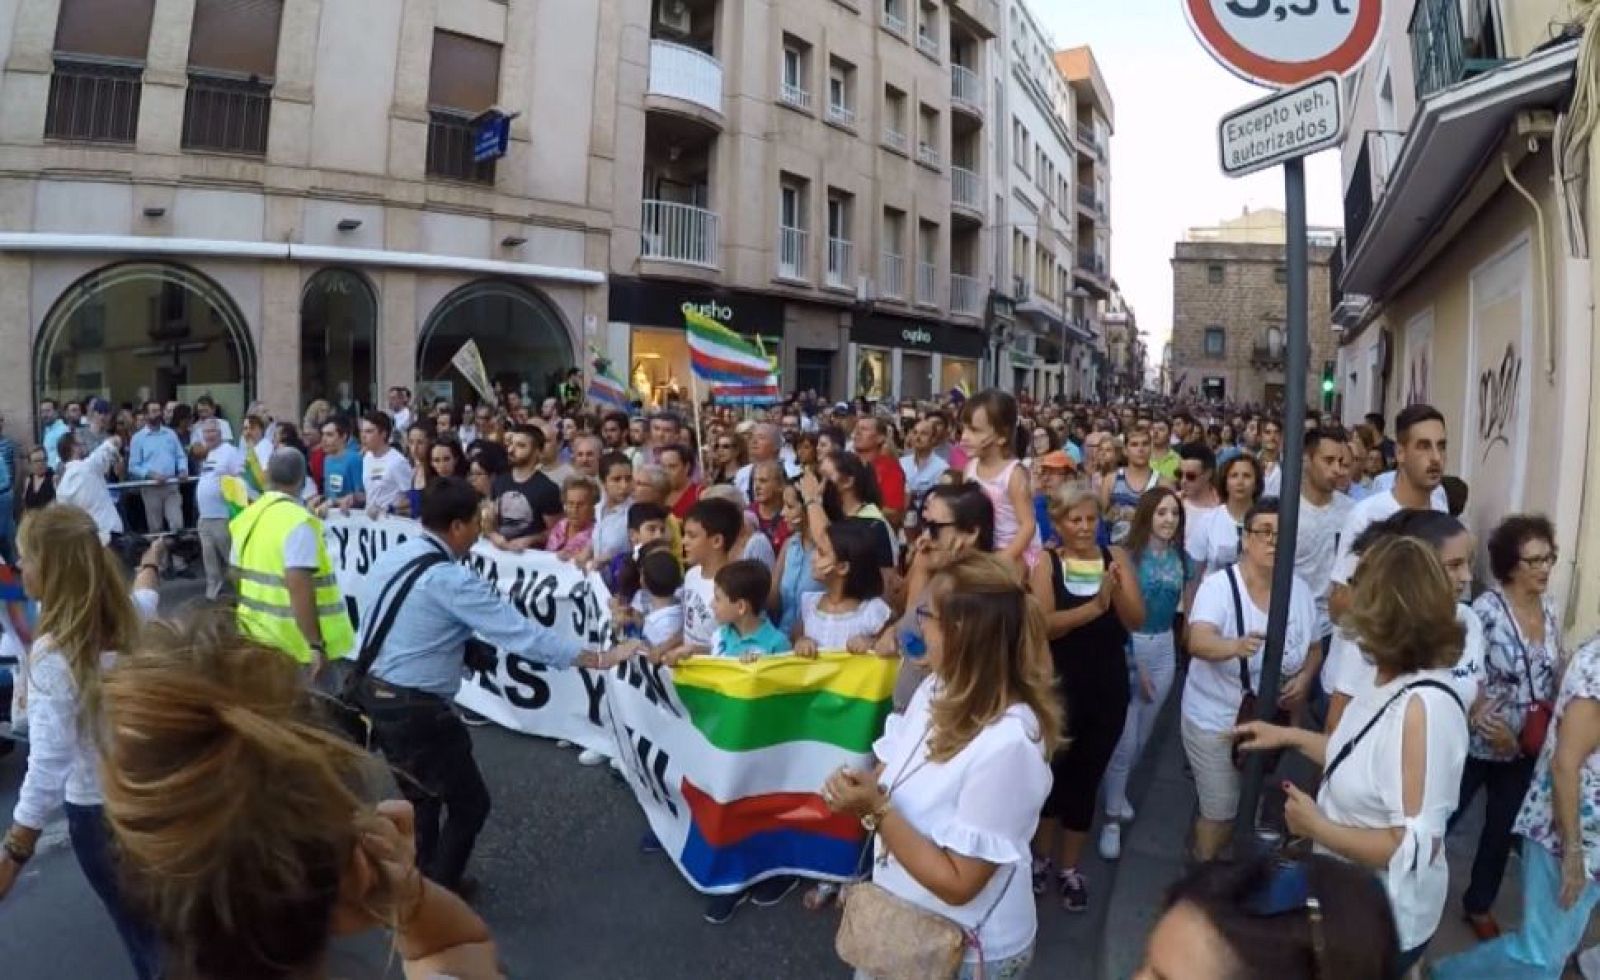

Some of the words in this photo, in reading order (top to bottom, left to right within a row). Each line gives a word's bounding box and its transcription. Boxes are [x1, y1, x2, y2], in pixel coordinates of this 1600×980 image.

[1226, 105, 1290, 143] Excepto
[1294, 91, 1330, 118] veh.
[1231, 118, 1328, 165] autorizados
[331, 525, 349, 571] Y
[509, 566, 559, 628] NO
